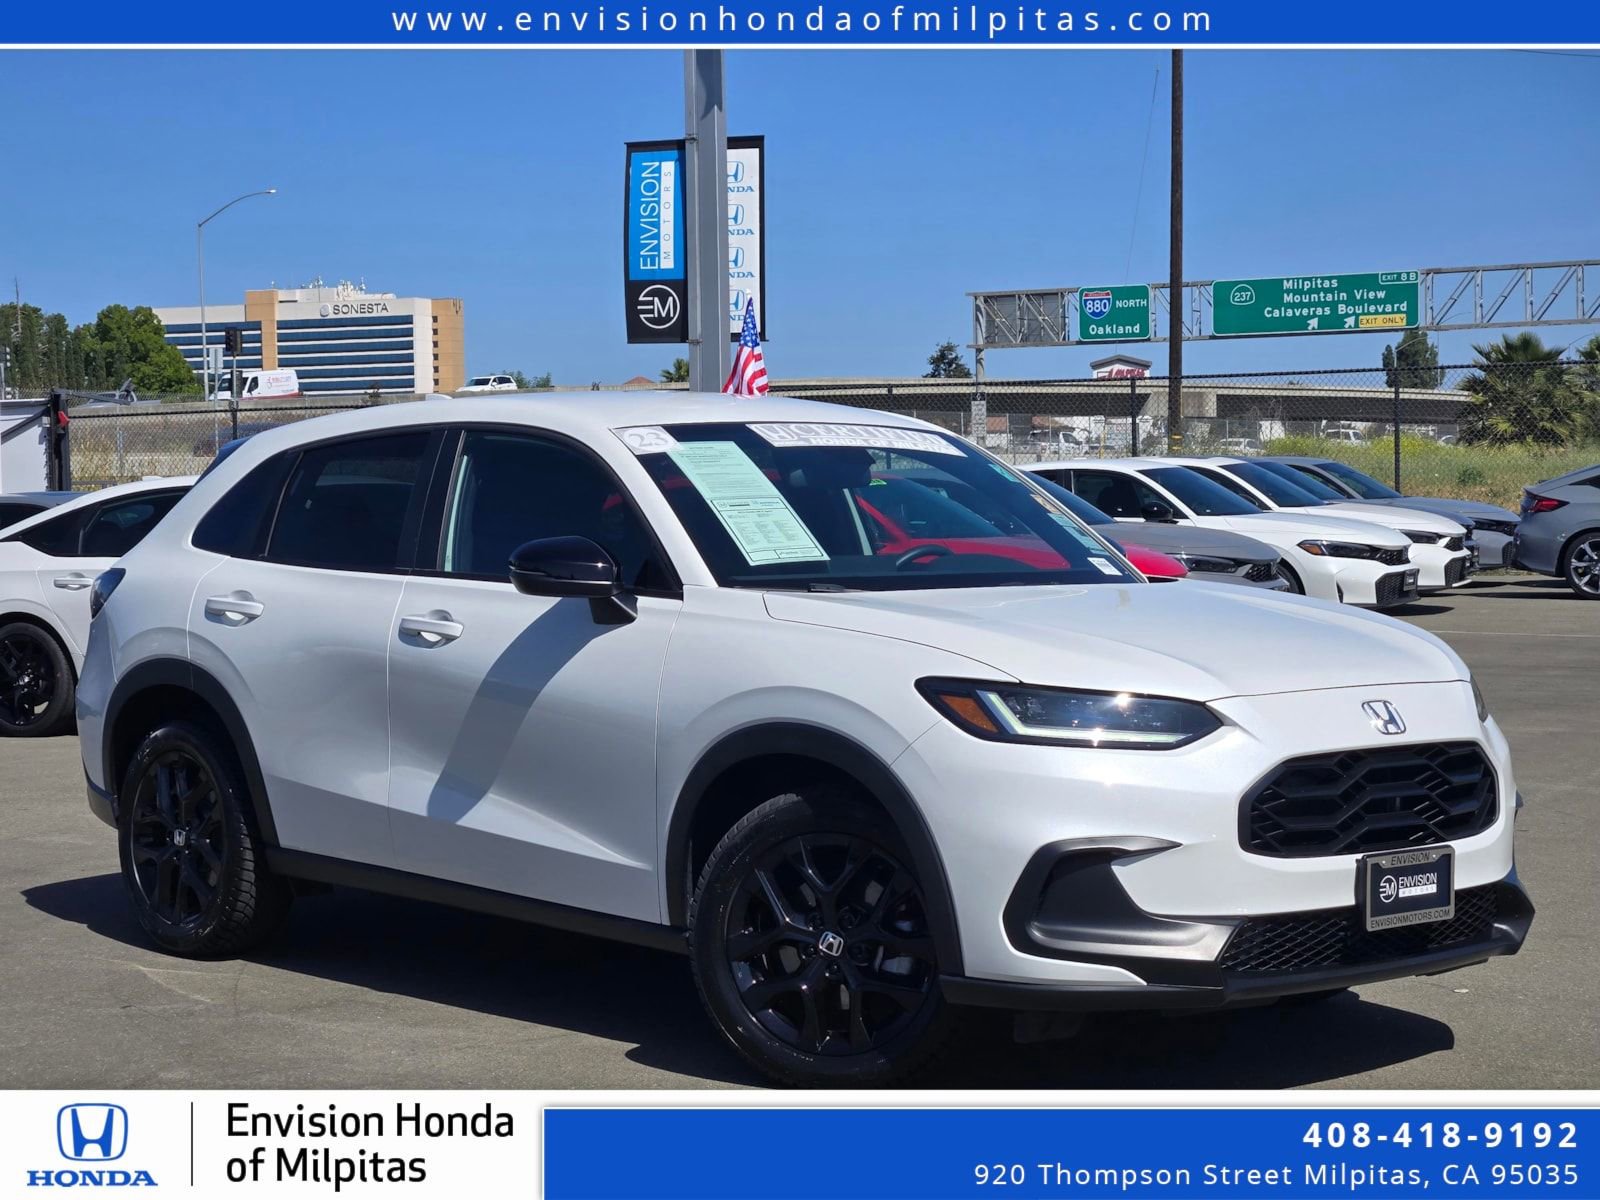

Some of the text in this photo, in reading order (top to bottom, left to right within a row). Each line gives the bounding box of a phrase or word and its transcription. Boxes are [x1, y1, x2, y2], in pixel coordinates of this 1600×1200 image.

[640, 161, 660, 270] ENVISION
[663, 171, 672, 260] MOTORS
[728, 228, 755, 236] NDA
[728, 271, 755, 279] NDA
[1283, 279, 1338, 291] Milpitas
[1234, 292, 1251, 302] 237
[1284, 289, 1386, 304] Mountain View
[333, 303, 389, 315] SONESTA
[1086, 299, 1109, 313] 880
[1116, 299, 1147, 308] NORTH
[1264, 301, 1408, 318] Calaveras Boulevard
[1360, 316, 1406, 325] EXIT ONLY
[1089, 323, 1141, 335] Oakland
[628, 432, 669, 448] 23
[809, 437, 868, 447] HONDA
[869, 438, 890, 448] OF
[1390, 852, 1431, 866] ENVISION
[1399, 872, 1438, 889] ENVISION
[1370, 908, 1450, 929] ENVISIONMOTORS.COM
